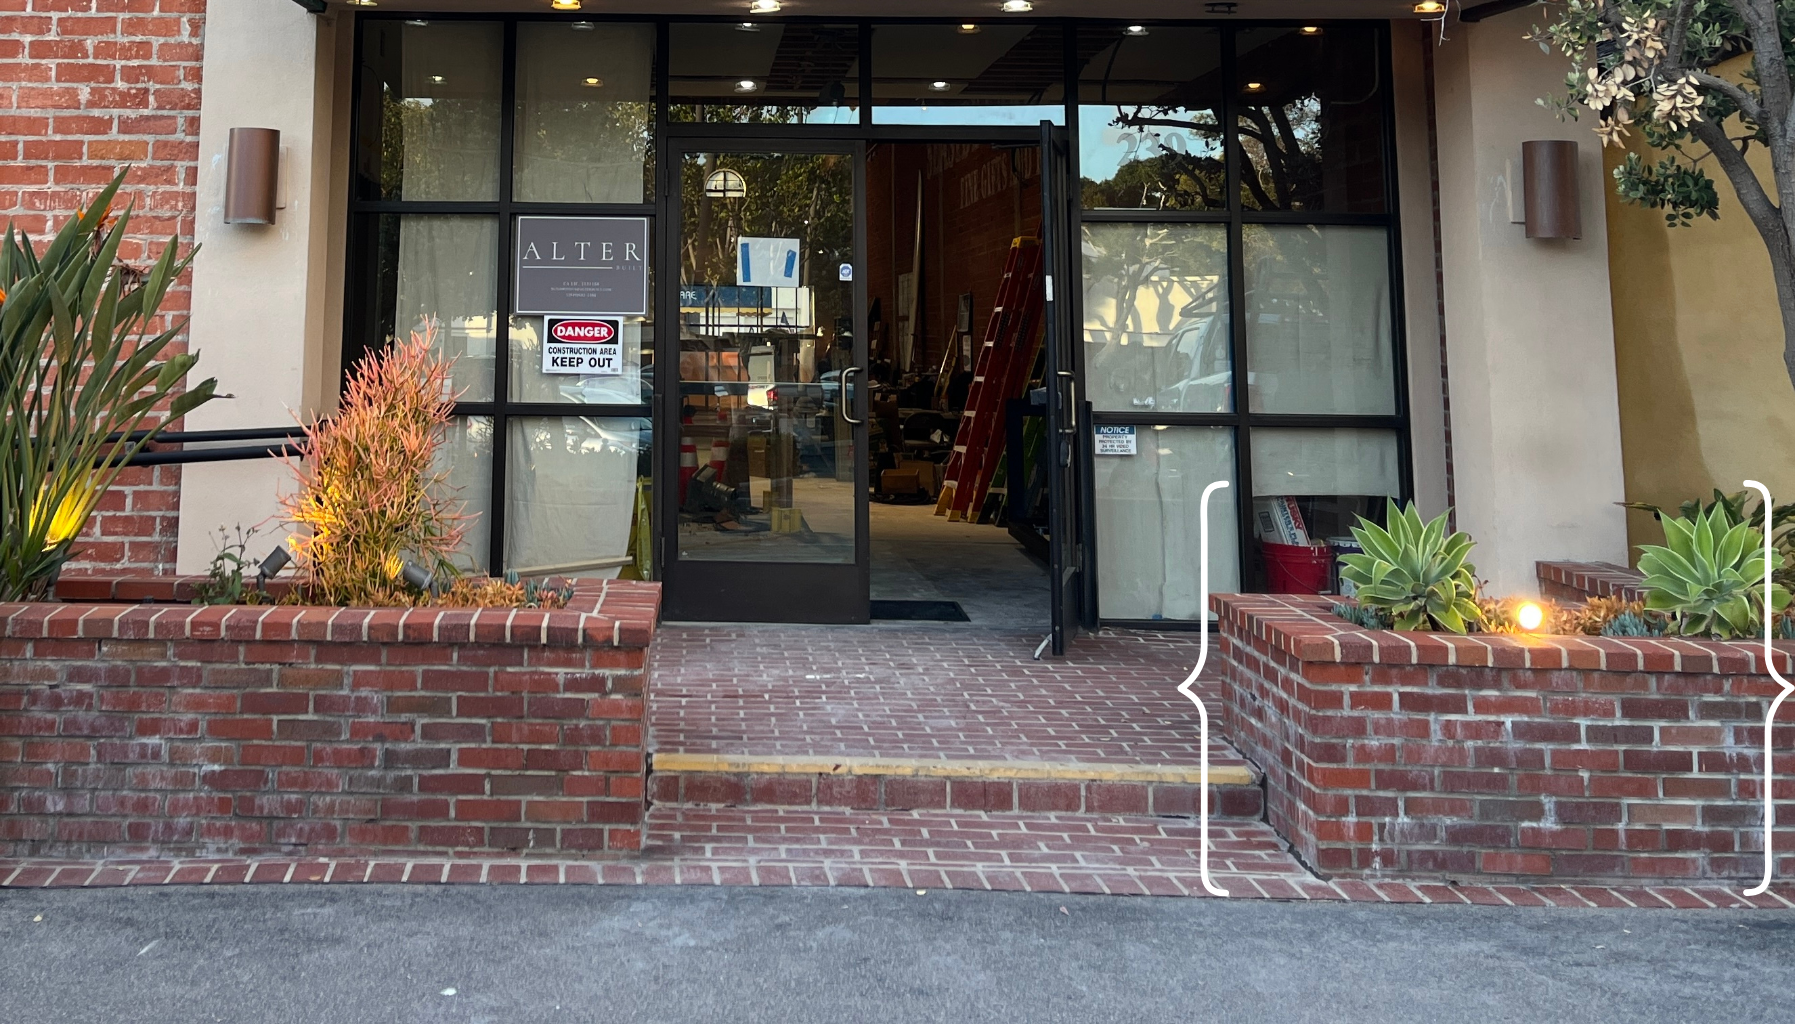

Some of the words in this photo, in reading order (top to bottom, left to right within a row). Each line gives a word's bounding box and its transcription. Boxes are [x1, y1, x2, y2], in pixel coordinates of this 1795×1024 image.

[522, 241, 641, 261] ALTER
[556, 326, 608, 338] DANGER
[548, 346, 597, 355] CONSTRUCTION
[600, 347, 617, 355] AREA
[551, 357, 584, 367] KEEP
[588, 358, 613, 368] OUT
[1100, 426, 1130, 434] NOTICE
